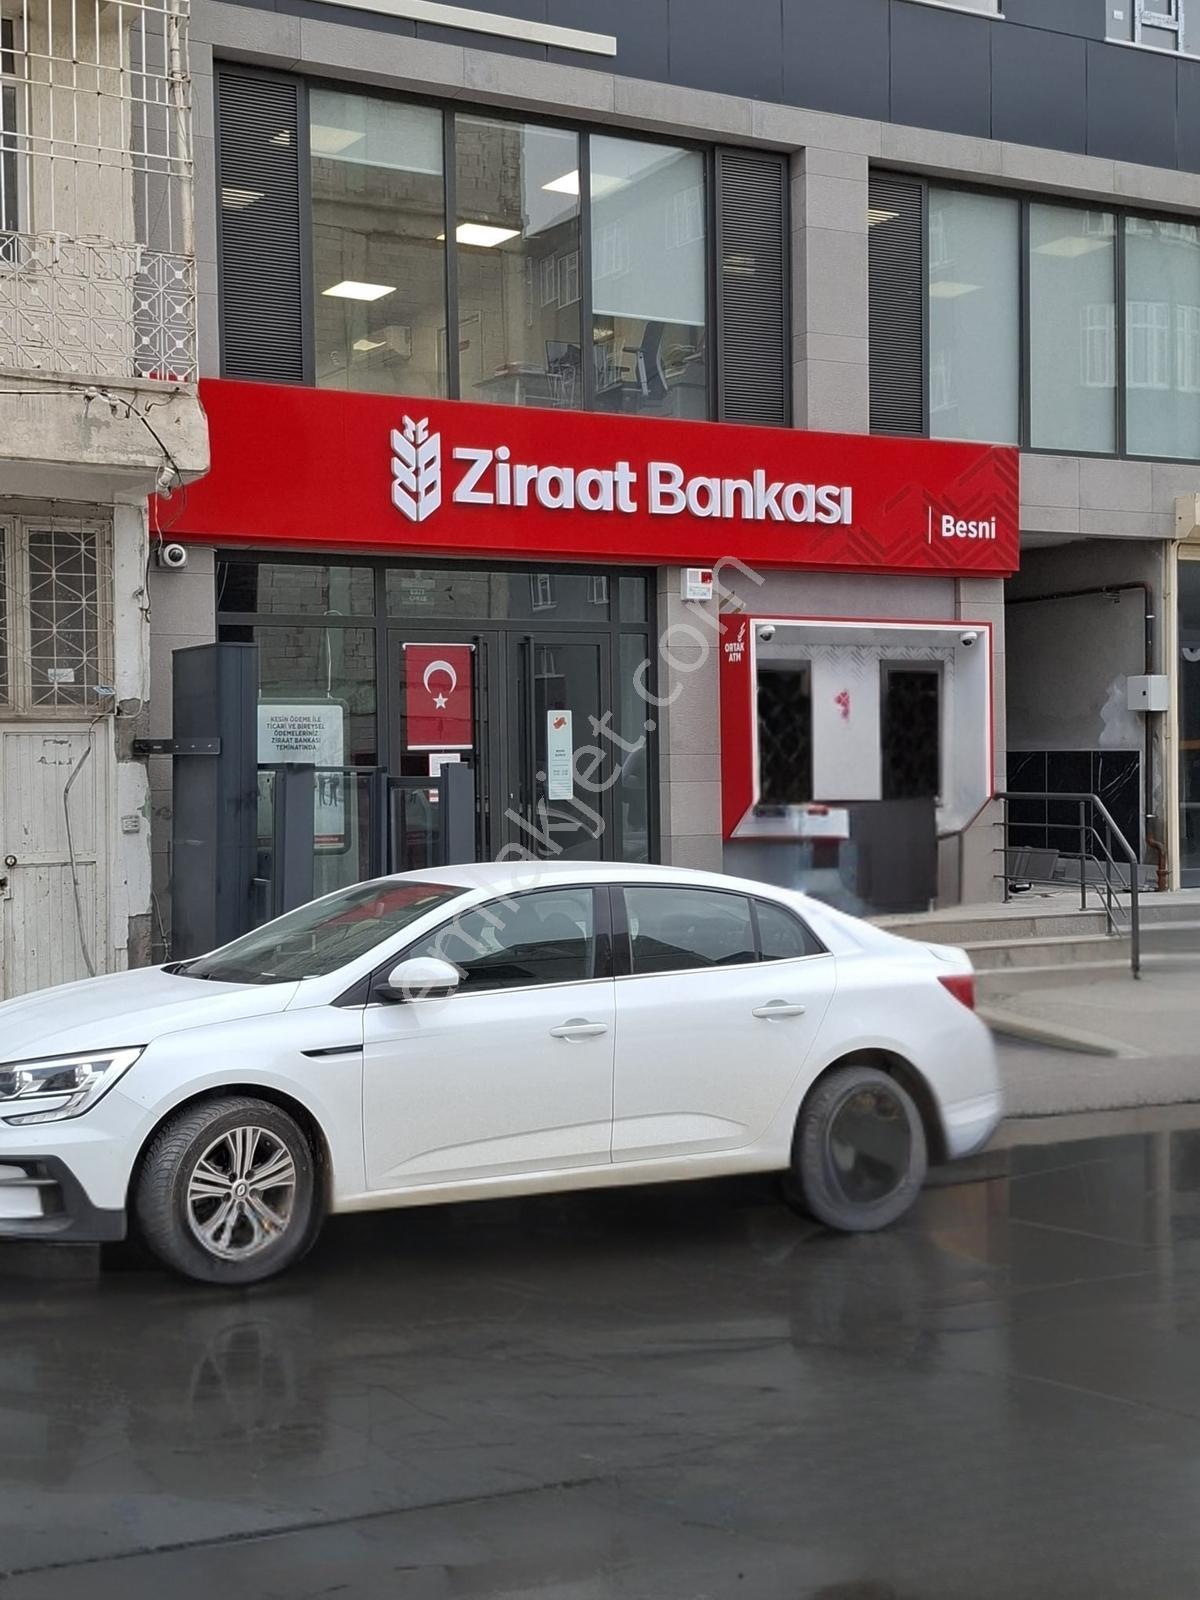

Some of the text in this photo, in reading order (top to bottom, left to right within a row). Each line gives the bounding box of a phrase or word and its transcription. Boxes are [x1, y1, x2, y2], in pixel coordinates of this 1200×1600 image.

[452, 445, 852, 525] Ziraat Bankası
[941, 514, 996, 539] Besni
[724, 642, 744, 652] ORTAK
[728, 652, 741, 662] ATM
